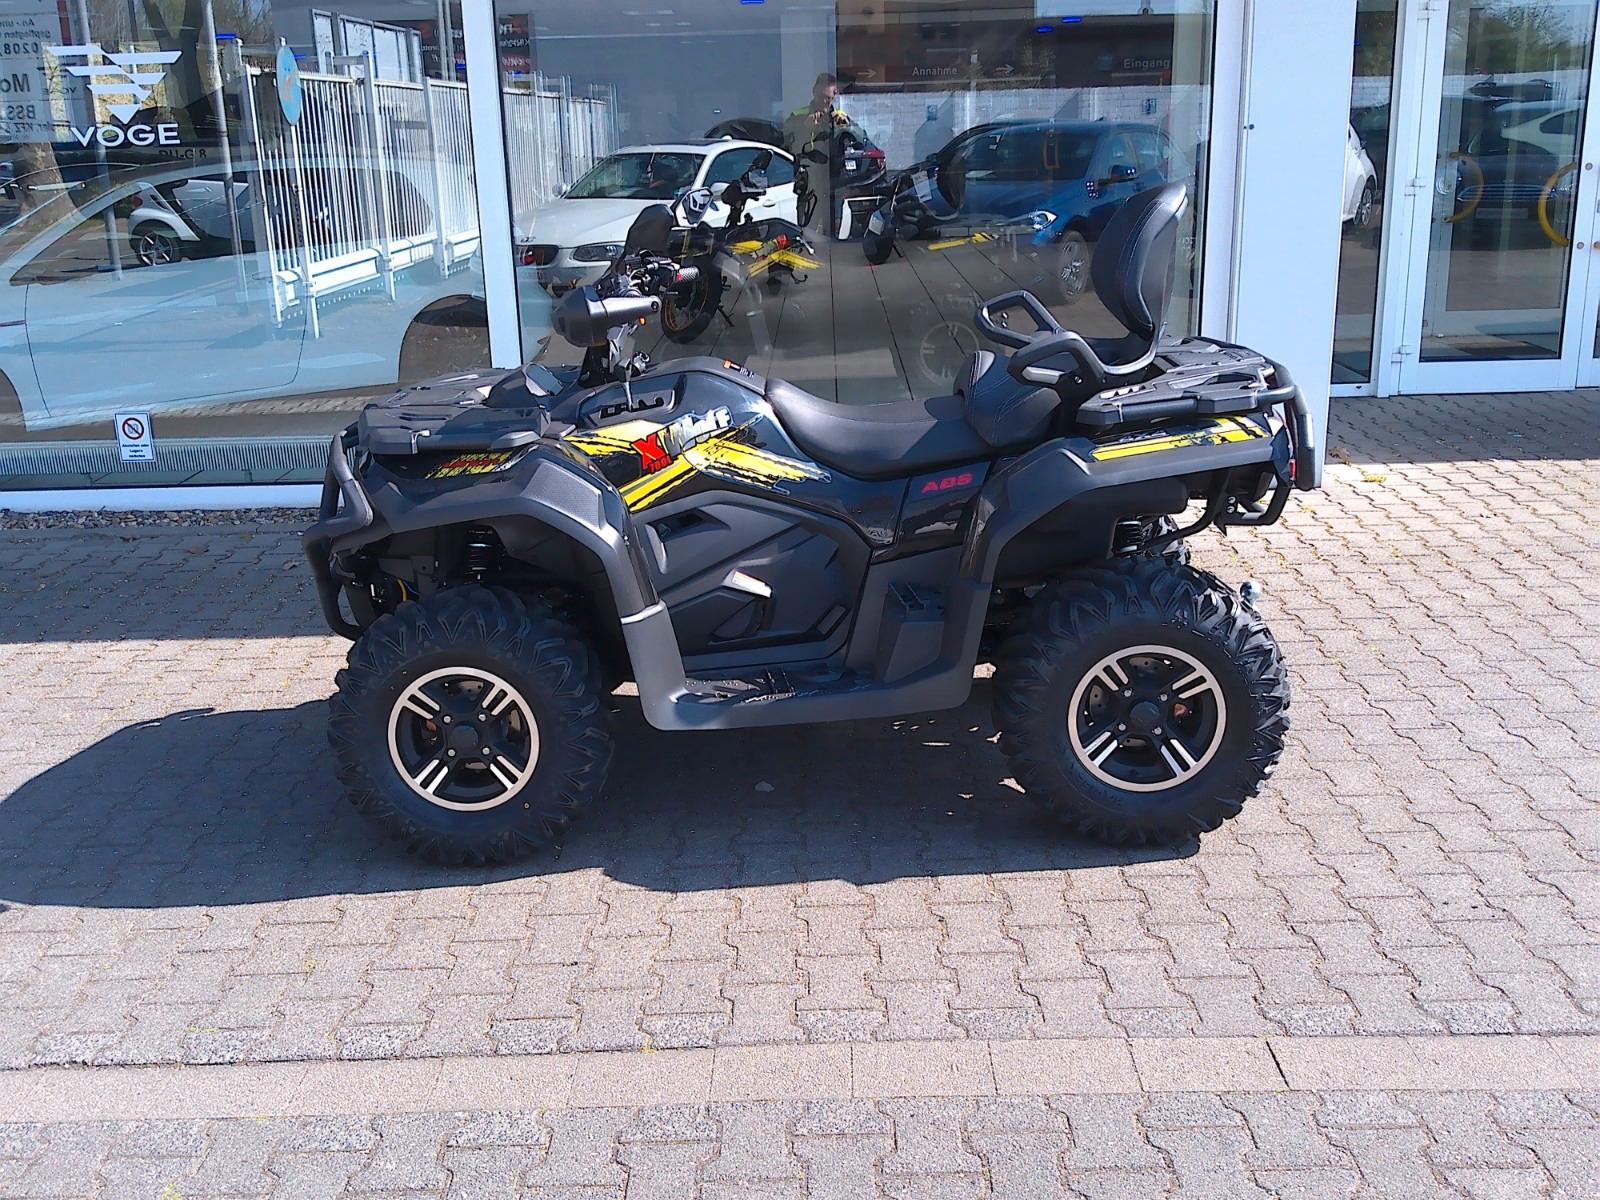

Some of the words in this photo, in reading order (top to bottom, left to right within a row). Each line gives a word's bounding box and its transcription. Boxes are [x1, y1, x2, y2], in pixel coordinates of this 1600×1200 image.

[912, 66, 958, 77] Annahme
[1123, 58, 1170, 70] Eingang
[70, 123, 181, 148] VOGE
[921, 472, 974, 494] ABS
